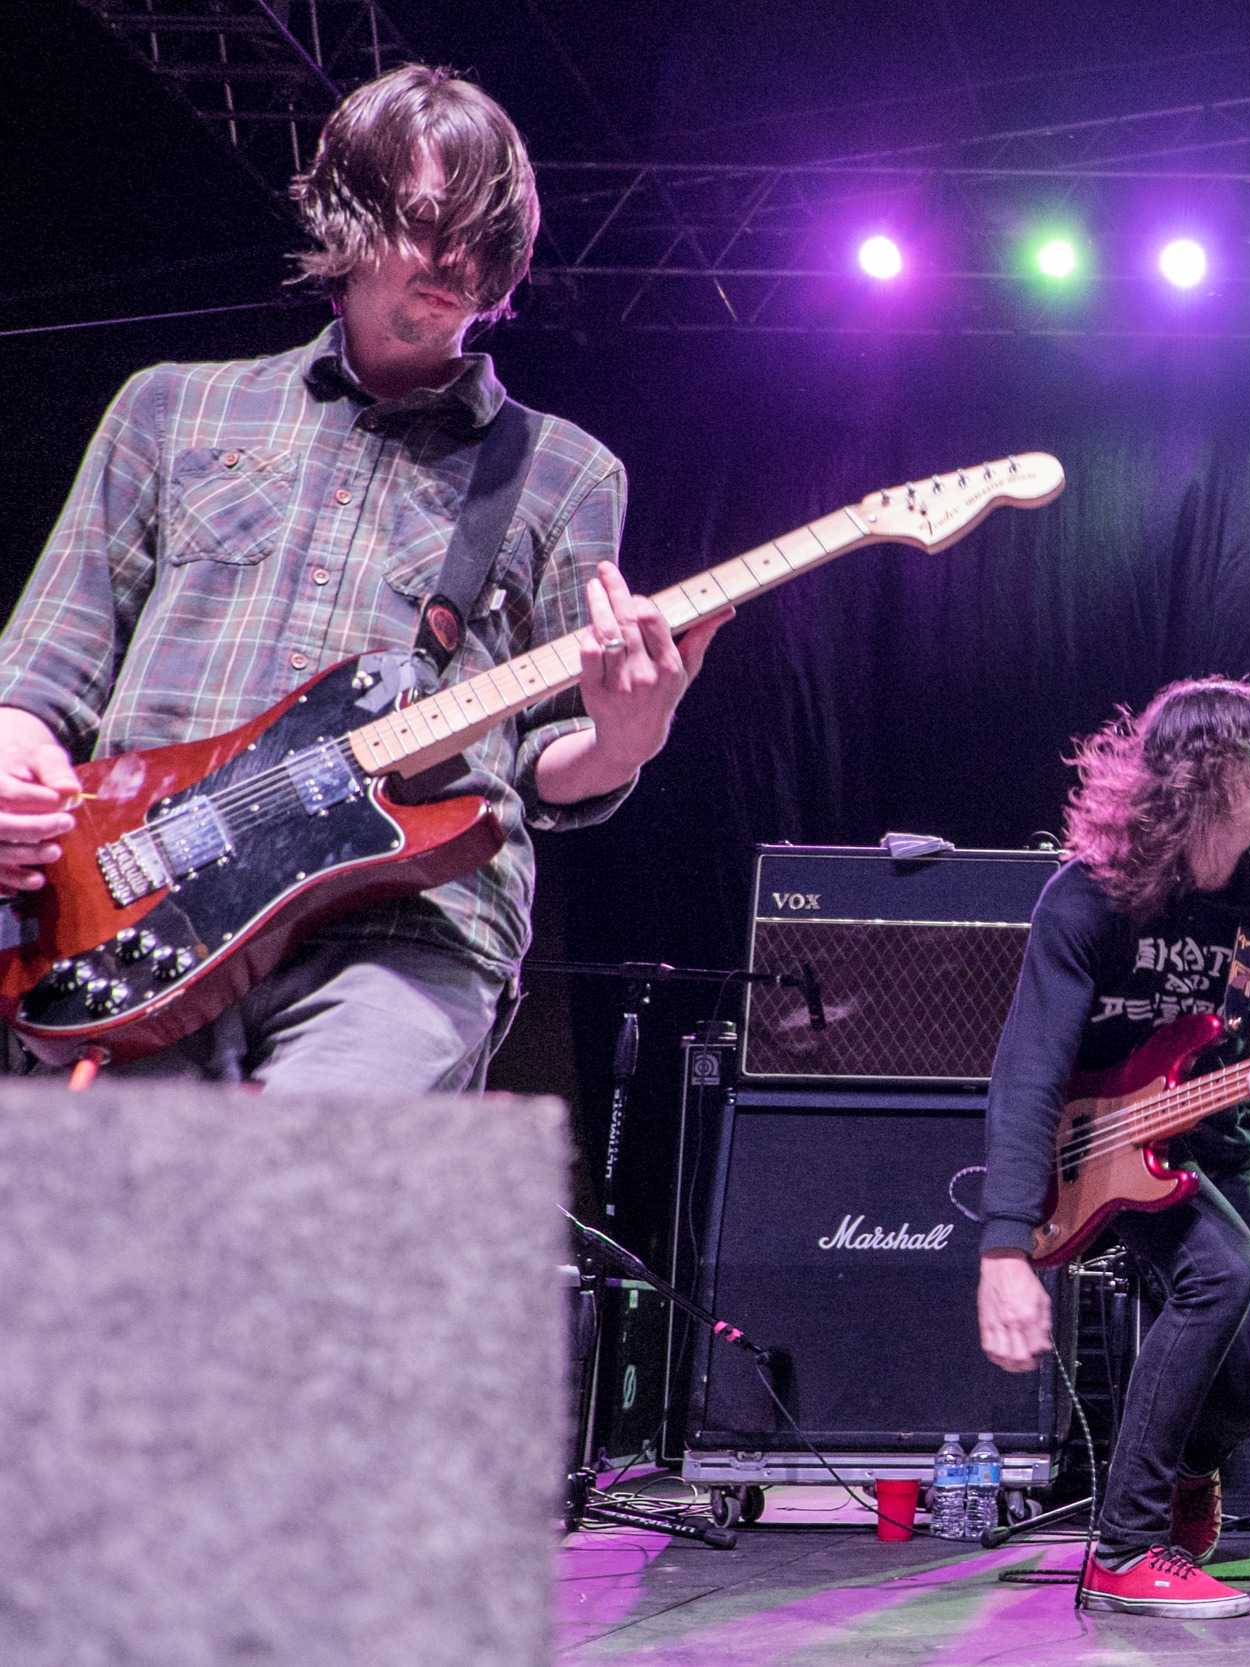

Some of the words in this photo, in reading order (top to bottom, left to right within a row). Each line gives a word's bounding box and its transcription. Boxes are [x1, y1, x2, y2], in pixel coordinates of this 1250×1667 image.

[772, 892, 822, 910] VOX
[1132, 937, 1234, 977] SKAT
[818, 1214, 955, 1250] Marshall
